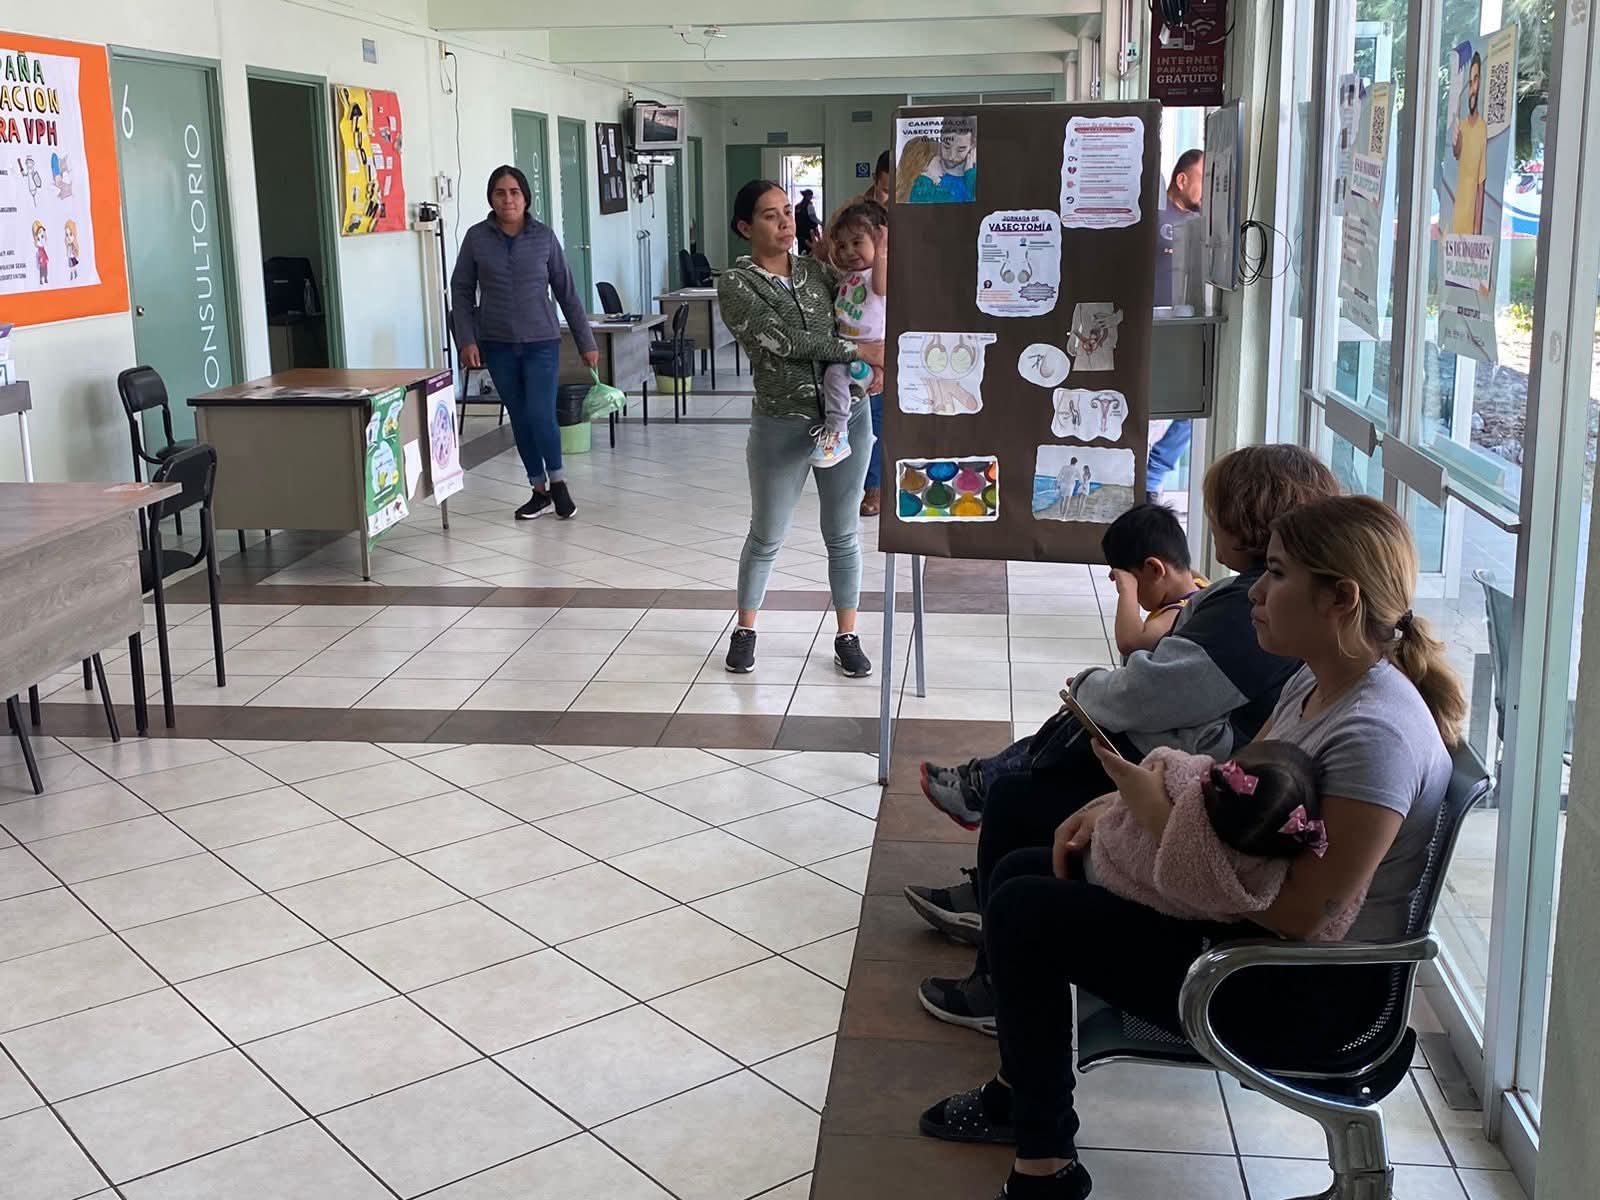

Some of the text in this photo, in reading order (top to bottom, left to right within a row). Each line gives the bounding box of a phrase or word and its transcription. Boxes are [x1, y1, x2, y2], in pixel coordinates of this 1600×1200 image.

[0, 51, 45, 85] AÑA
[1156, 55, 1218, 65] INTERNET
[1156, 74, 1218, 84] GRATUITO
[121, 84, 135, 140] 6
[23, 117, 58, 146] VPH
[183, 123, 221, 389] ONSULTORIO
